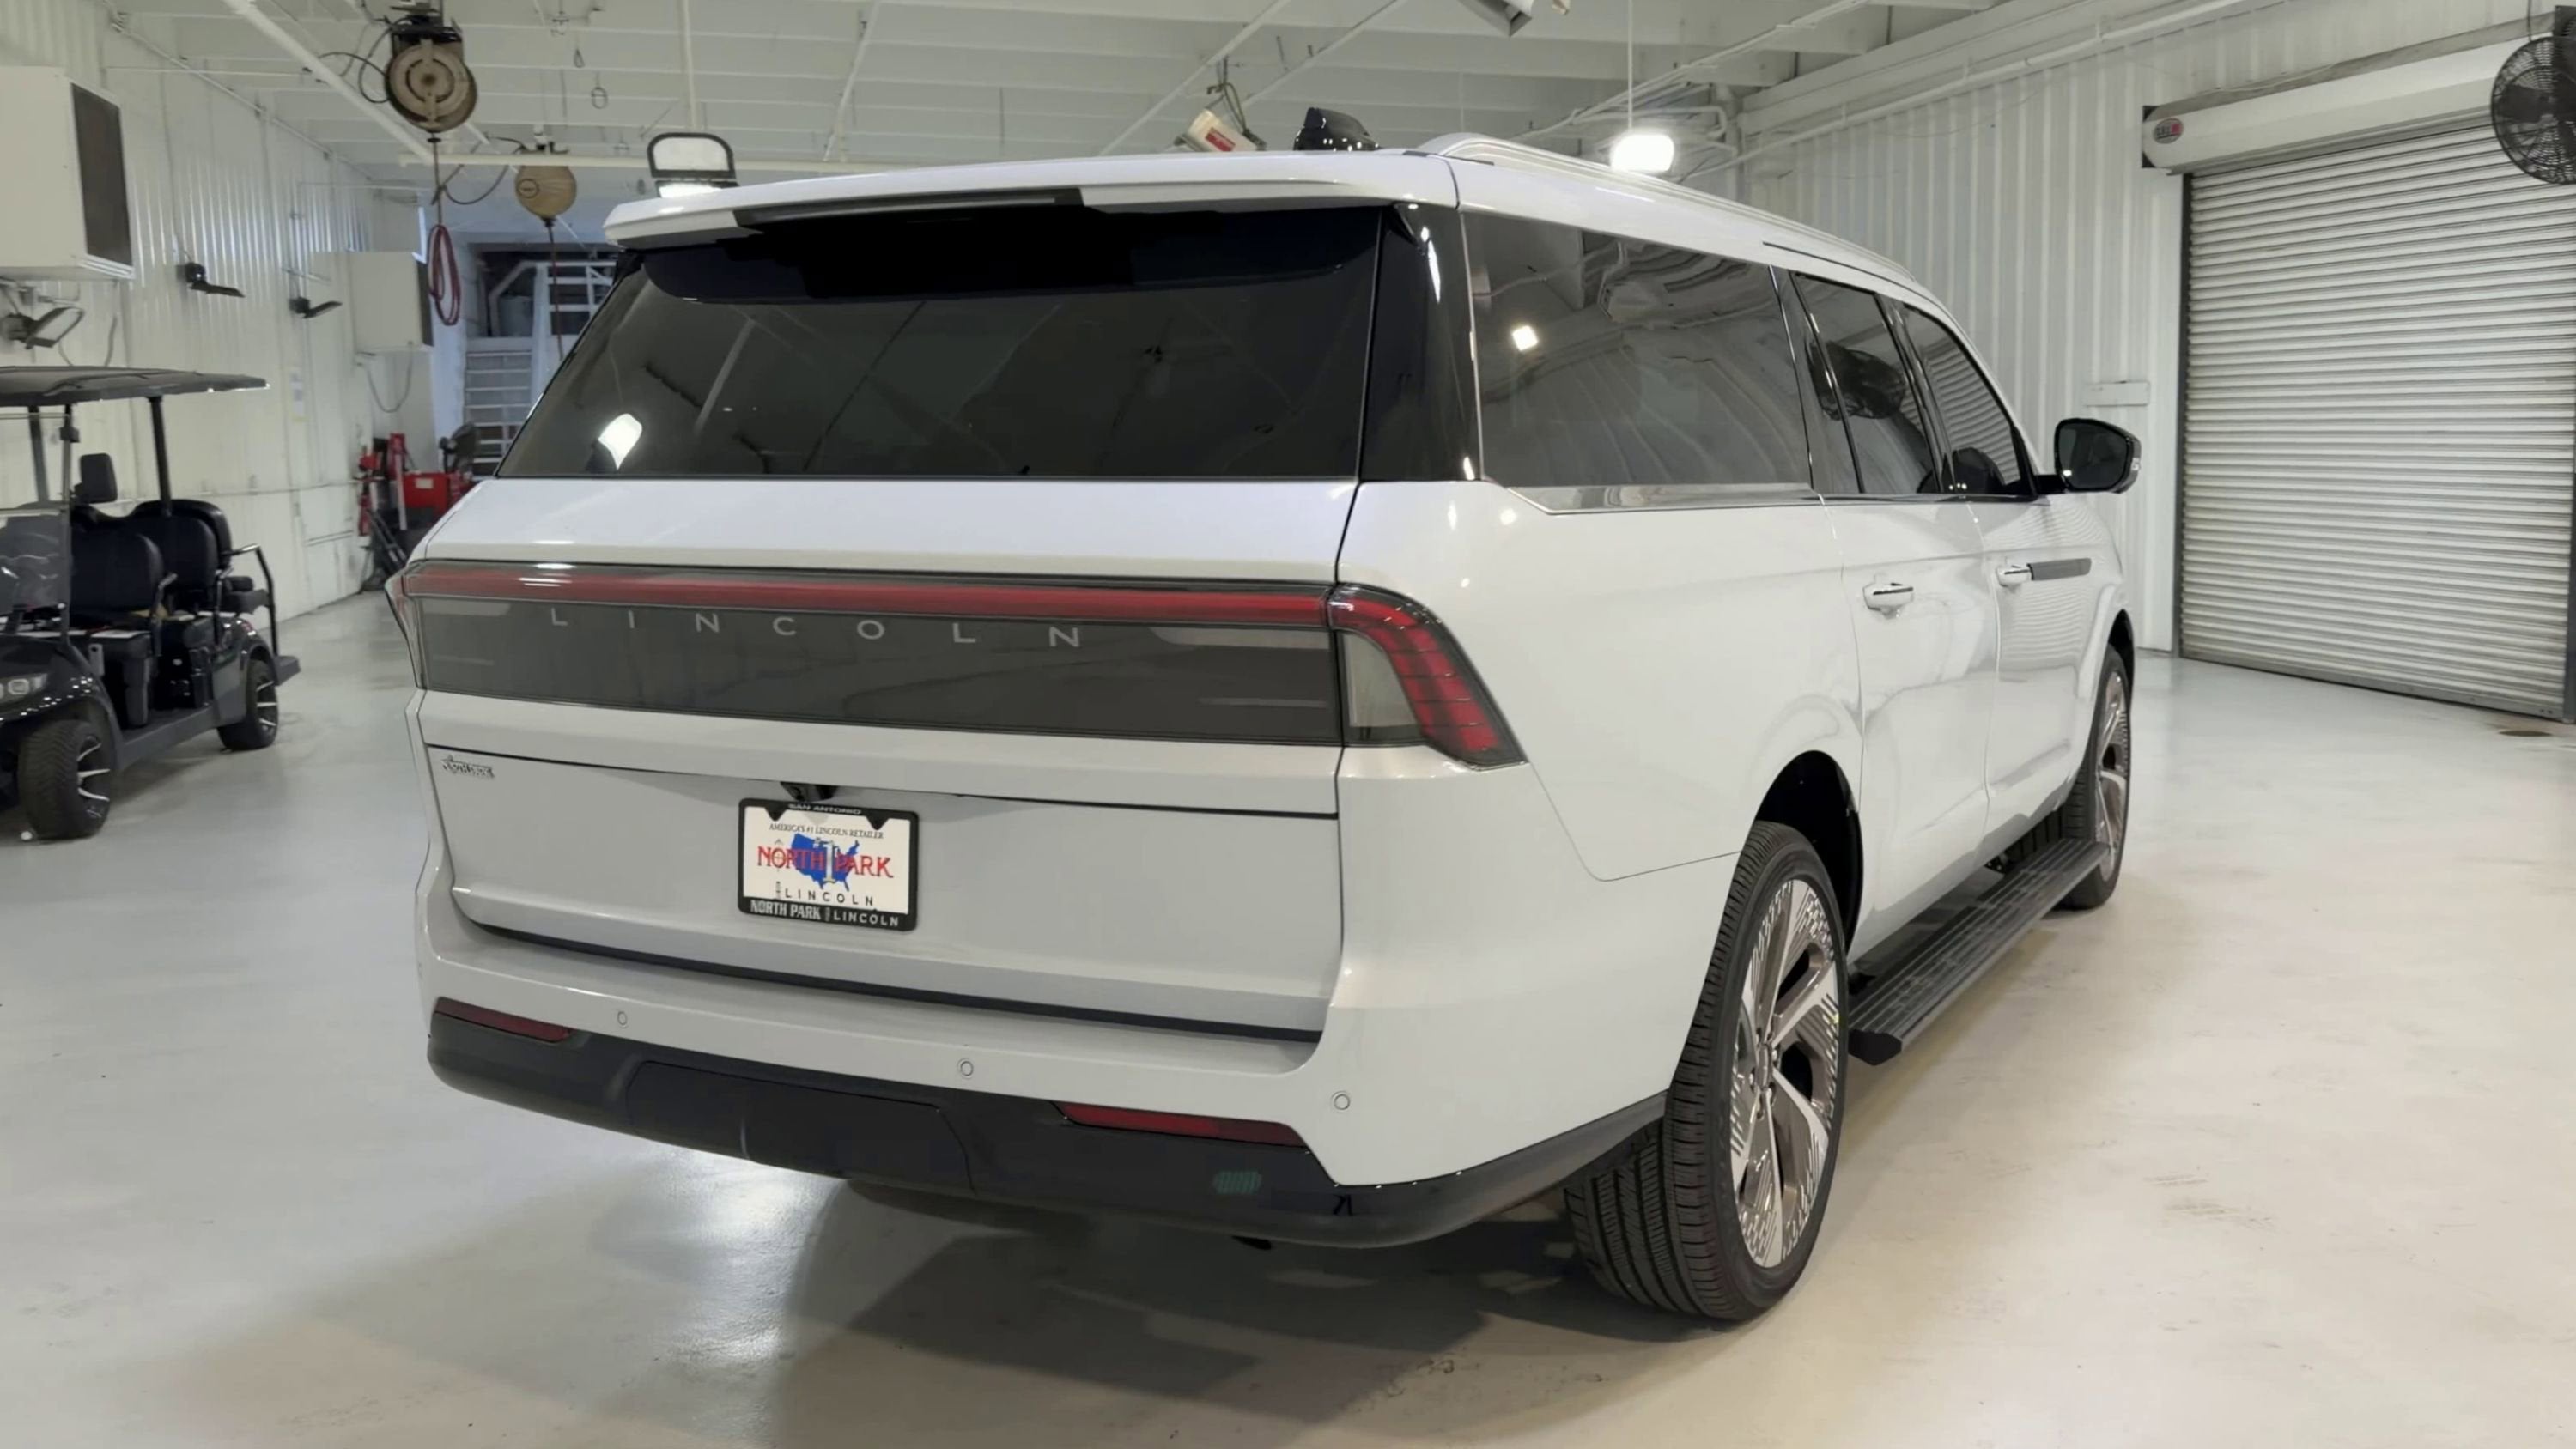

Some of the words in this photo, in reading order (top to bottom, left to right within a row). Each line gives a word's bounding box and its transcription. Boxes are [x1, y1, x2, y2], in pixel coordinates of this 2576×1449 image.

[550, 606, 1080, 648] LINCOLN
[815, 827, 848, 837] LINCOLN
[848, 829, 884, 840] RETAILER
[757, 845, 826, 870] NORTH
[834, 850, 894, 879] PARK
[785, 887, 873, 907] LINCOLN
[750, 900, 787, 917] NORTH
[790, 904, 821, 920] PARK
[834, 910, 899, 926] LINCOLN
